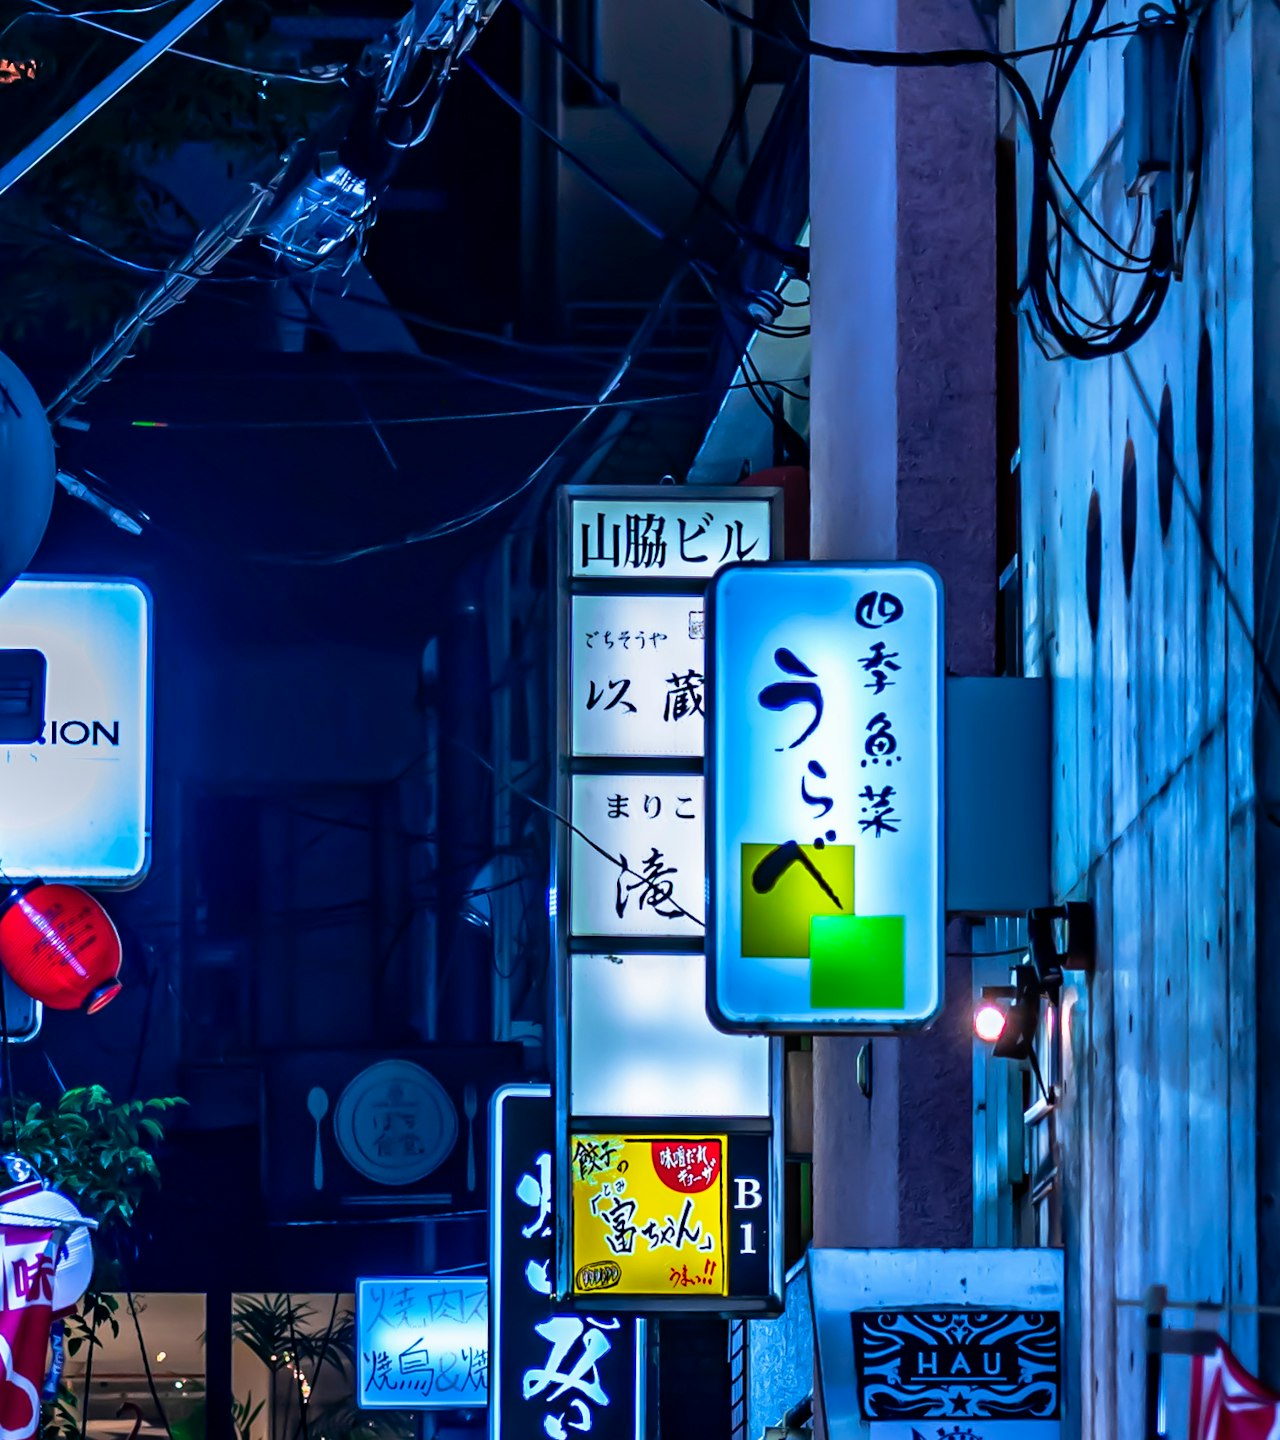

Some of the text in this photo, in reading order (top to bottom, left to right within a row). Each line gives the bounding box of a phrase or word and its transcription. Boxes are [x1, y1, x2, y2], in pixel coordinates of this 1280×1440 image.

[580, 511, 760, 569] 山脇ビル
[584, 629, 668, 650] ごちそうや
[751, 647, 844, 911] うらべ
[607, 794, 697, 820] まりこ
[573, 1141, 630, 1180] 餃子の
[917, 1351, 1004, 1377] HAU
